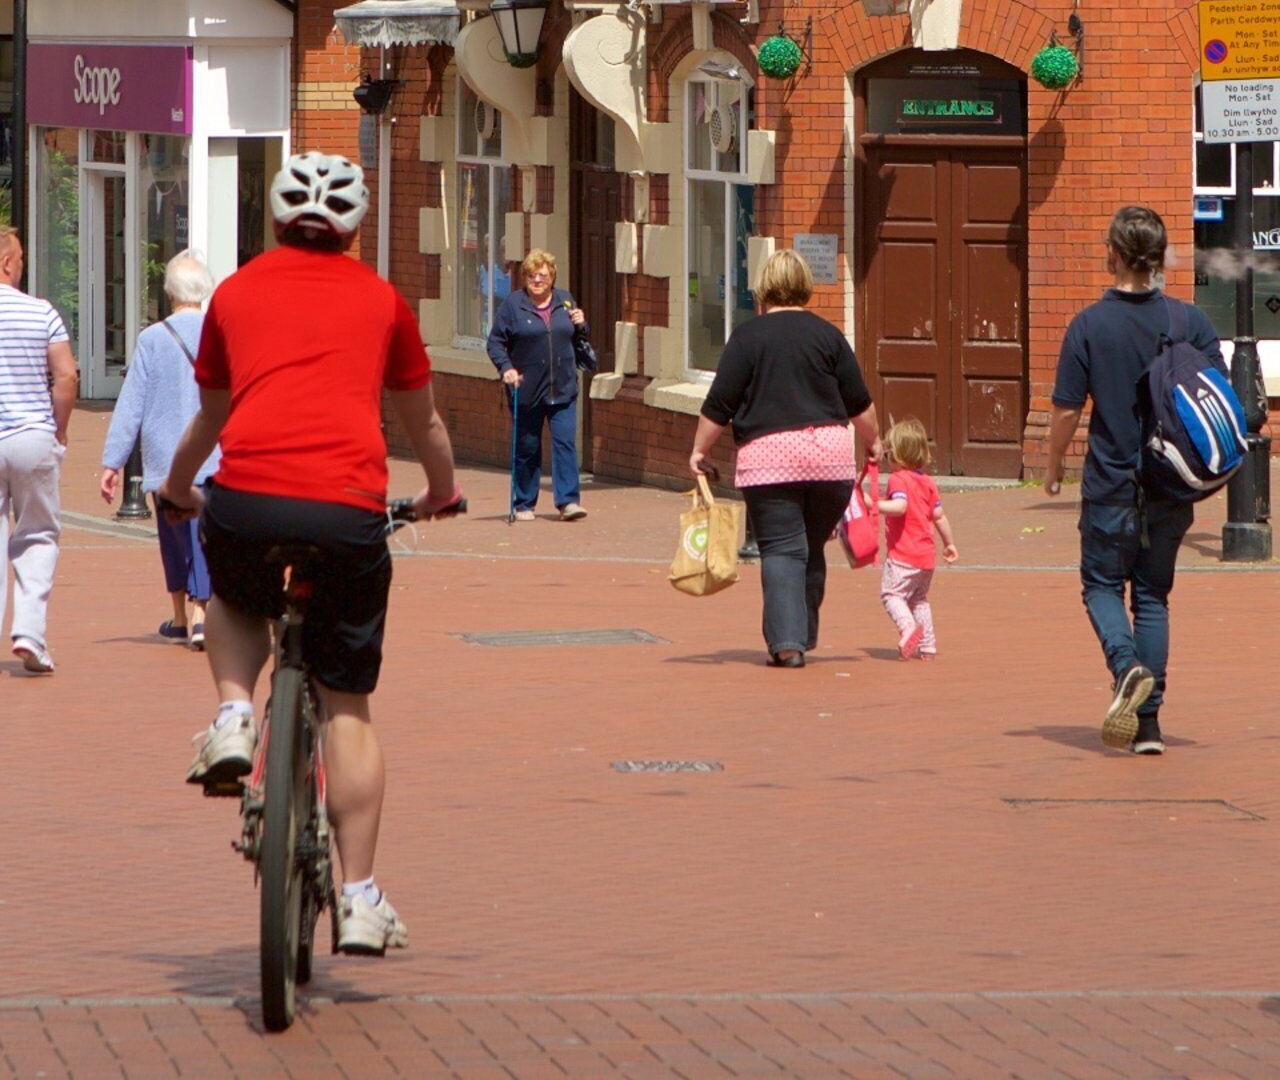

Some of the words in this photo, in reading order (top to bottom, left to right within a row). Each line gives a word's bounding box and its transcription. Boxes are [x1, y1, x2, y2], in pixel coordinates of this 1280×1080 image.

[1209, 5, 1257, 13] Pedestrian
[1210, 17, 1235, 25] Parth
[1238, 16, 1280, 24] Cerddwyr
[1243, 40, 1259, 49] Any
[1262, 54, 1279, 62] Sad
[73, 54, 121, 115] Scope
[1241, 83, 1274, 92] loading
[1228, 94, 1248, 102] Mon
[1255, 93, 1271, 101] Sat
[903, 100, 995, 115] ENTRANCE
[1223, 109, 1241, 117] Dim
[1243, 107, 1277, 117] llwytho
[1228, 119, 1248, 127] Llun
[1255, 118, 1273, 126] Sad
